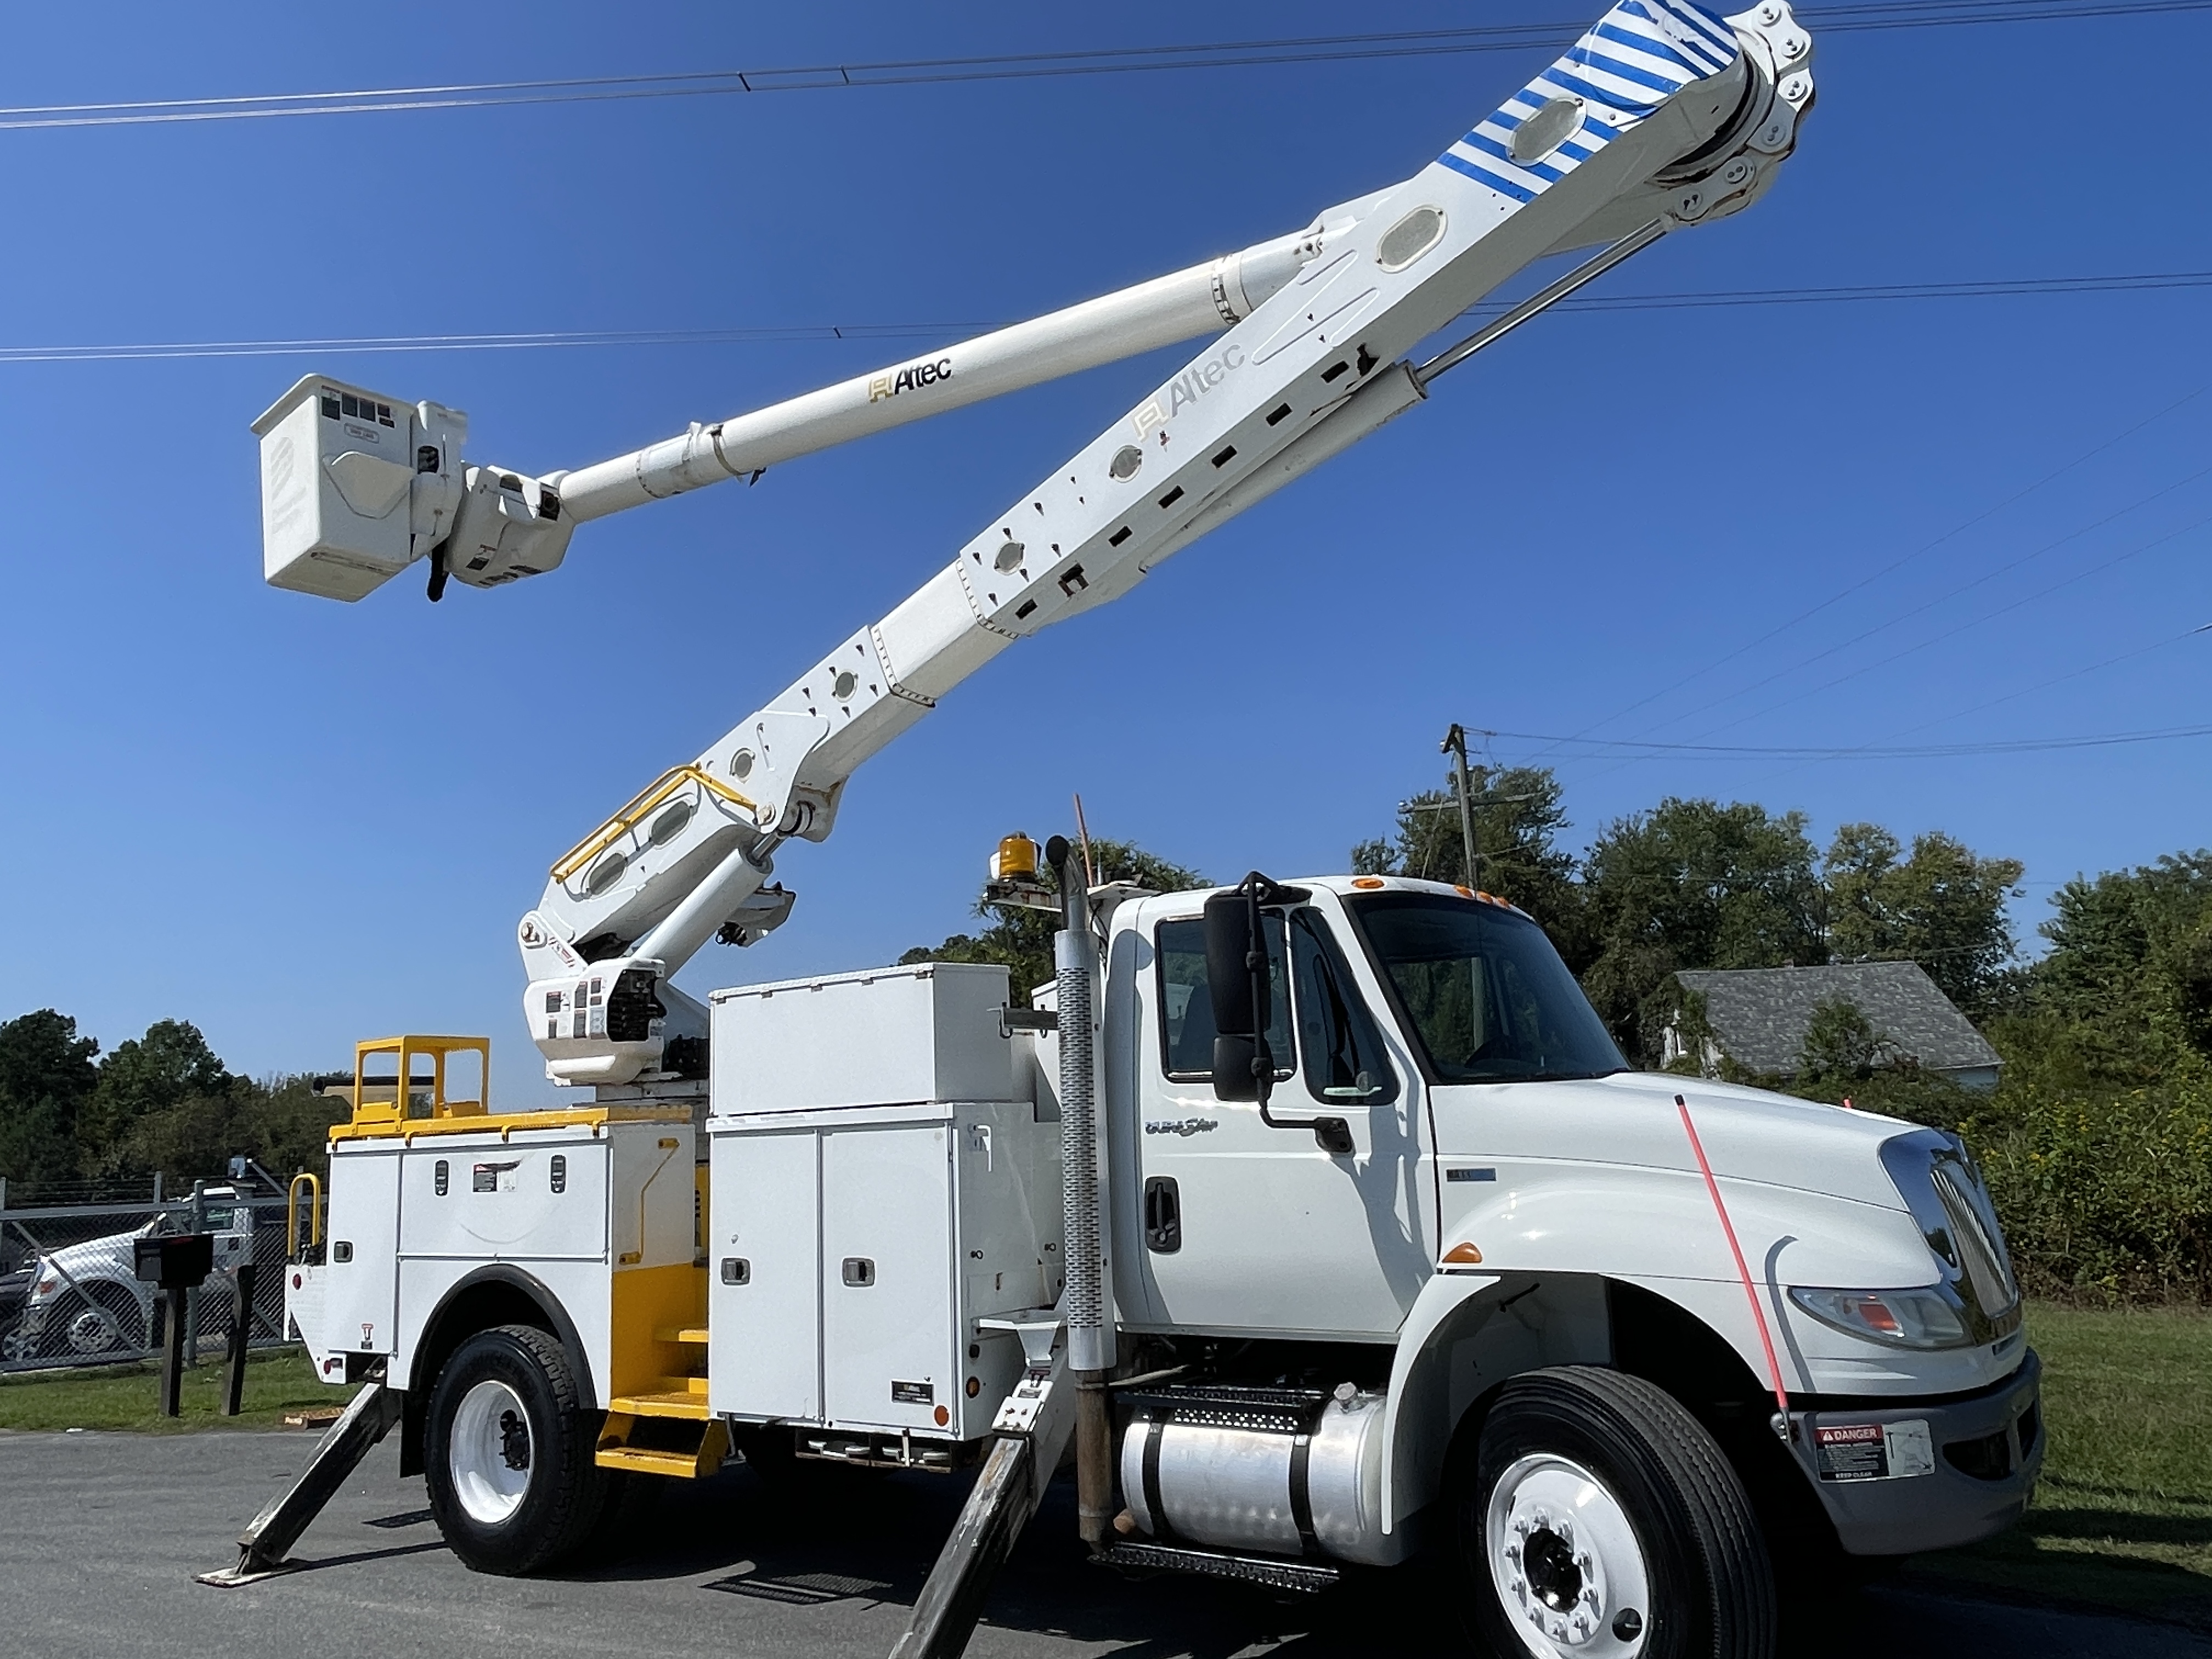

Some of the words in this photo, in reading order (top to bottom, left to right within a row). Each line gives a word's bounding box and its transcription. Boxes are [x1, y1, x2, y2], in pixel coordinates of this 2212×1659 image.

[895, 358, 952, 394] Altec
[1170, 344, 1245, 419] Altec
[1834, 1428, 1877, 1441] DANGER
